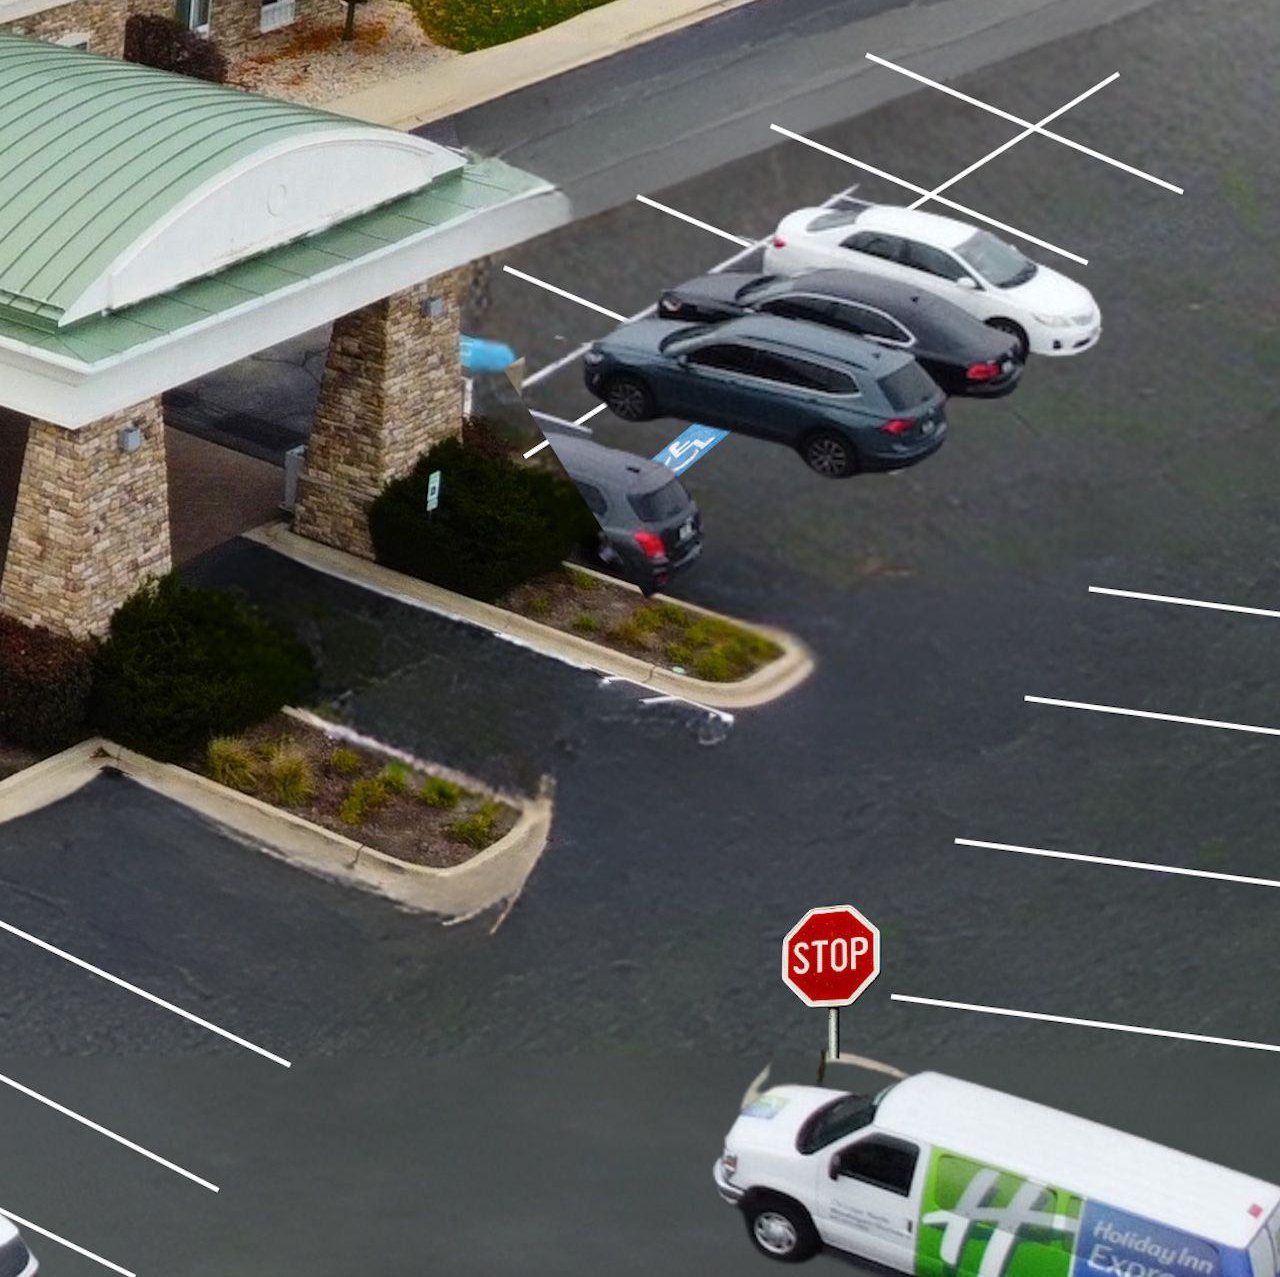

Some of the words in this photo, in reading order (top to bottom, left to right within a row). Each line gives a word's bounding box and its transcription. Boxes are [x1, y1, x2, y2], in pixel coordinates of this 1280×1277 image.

[793, 936, 869, 975] STOP
[1093, 1221, 1176, 1266] Holiday
[1178, 1247, 1215, 1275] Inn
